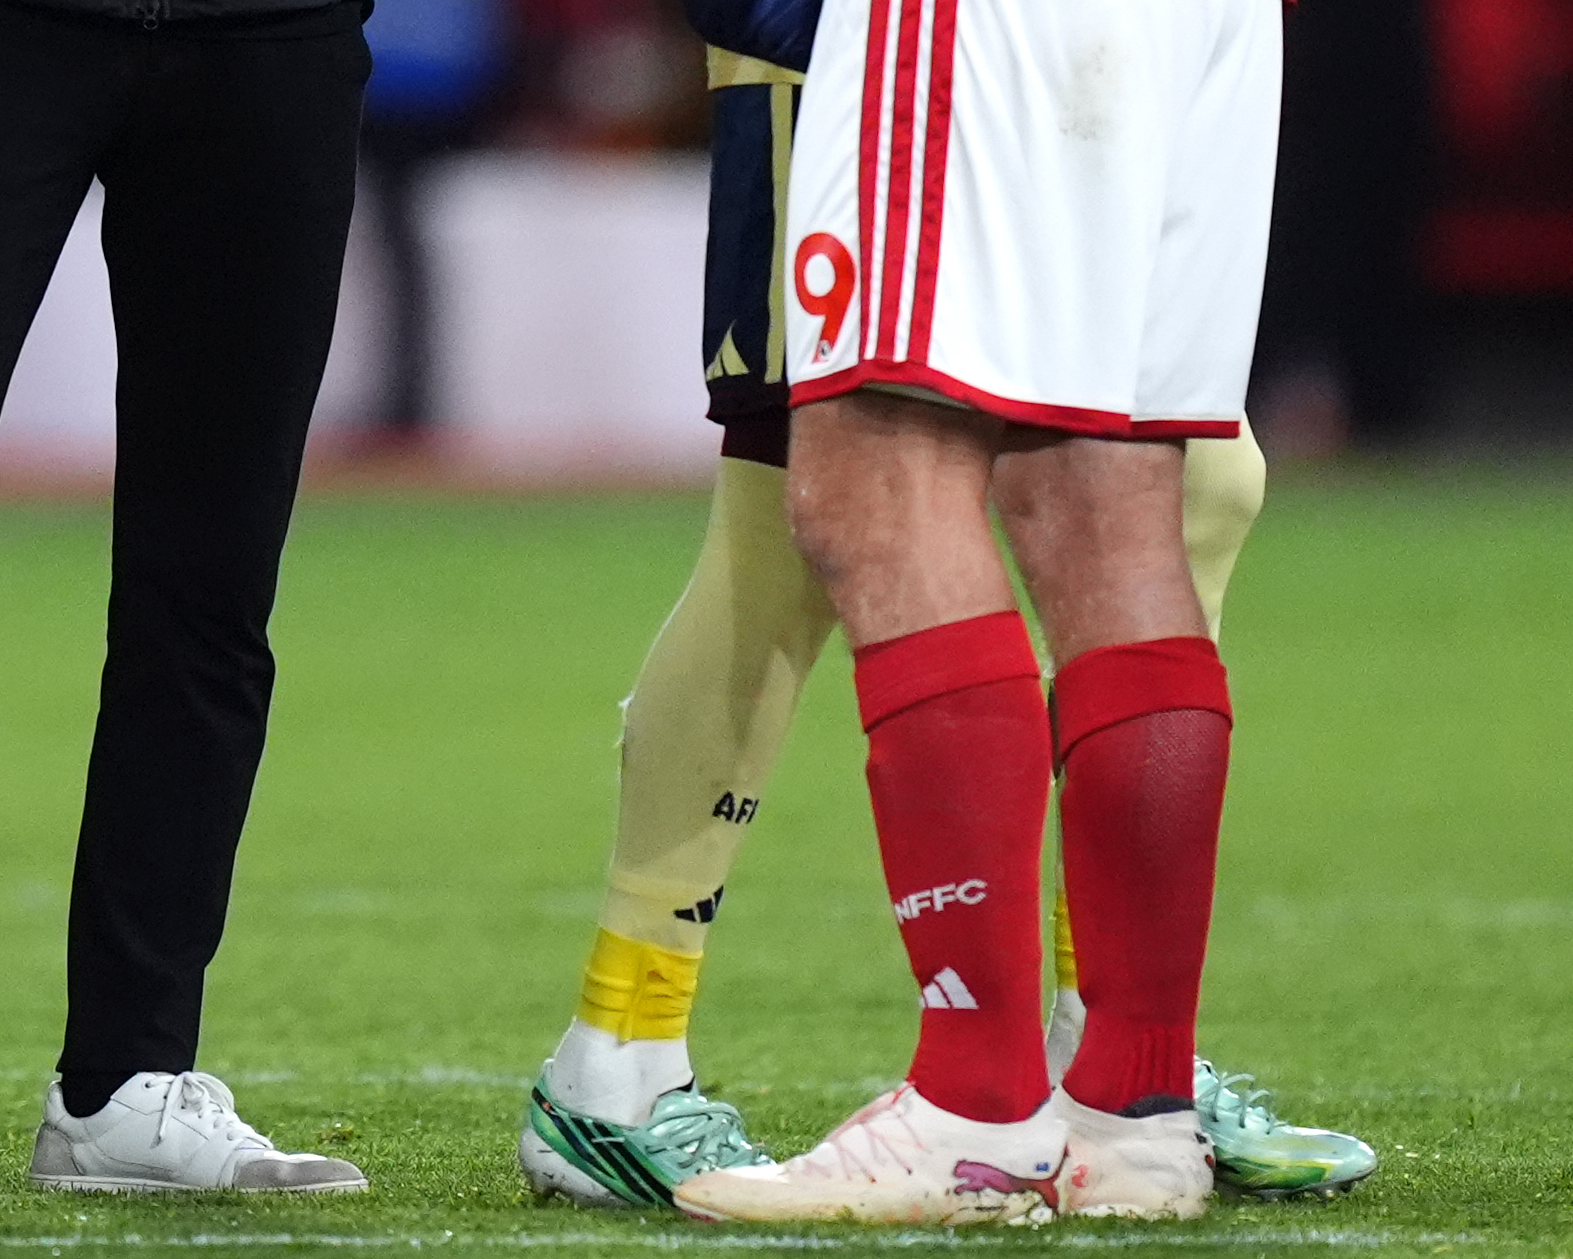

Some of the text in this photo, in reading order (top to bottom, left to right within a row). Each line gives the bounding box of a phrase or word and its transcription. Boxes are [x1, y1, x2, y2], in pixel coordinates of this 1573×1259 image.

[794, 232, 856, 364] 9
[712, 790, 760, 825] AF
[894, 878, 988, 925] NFFC
